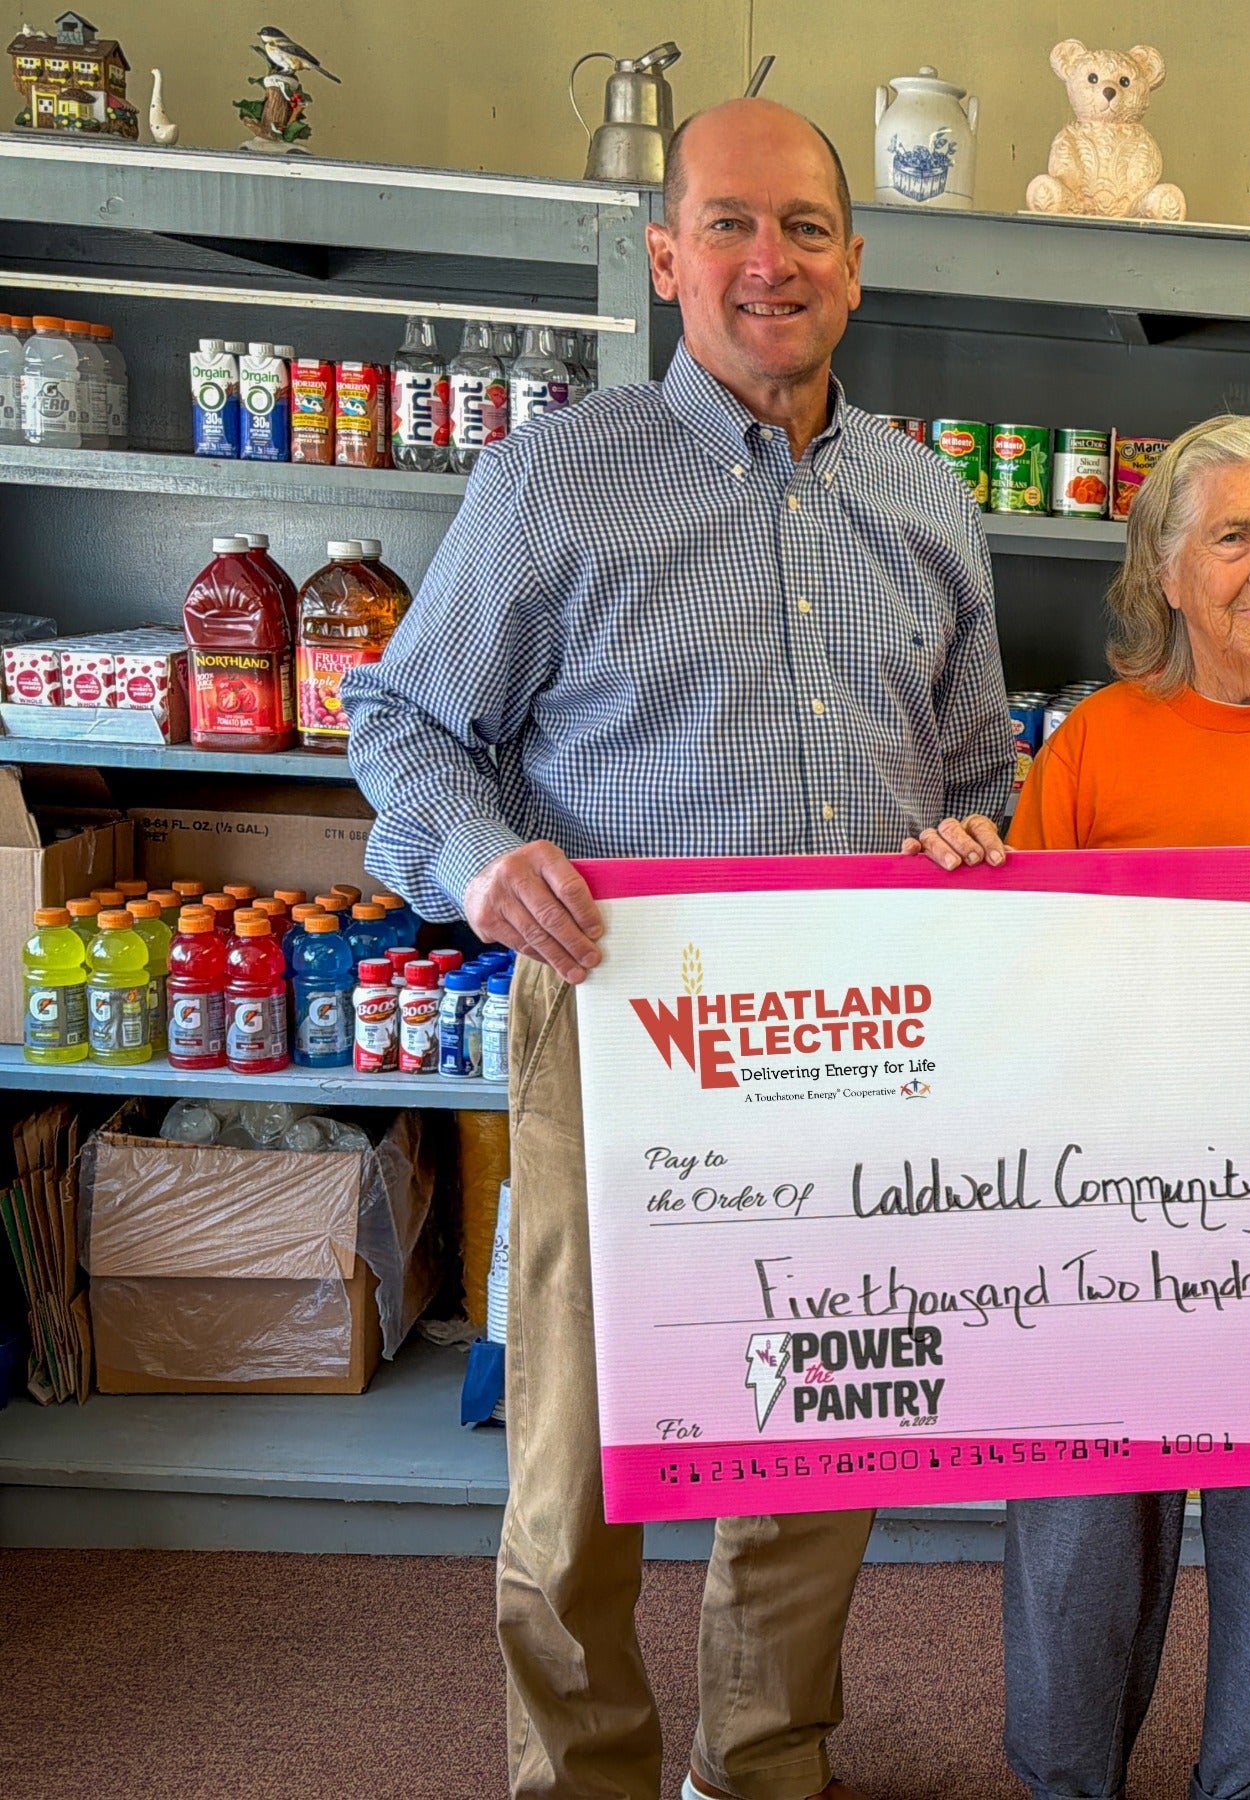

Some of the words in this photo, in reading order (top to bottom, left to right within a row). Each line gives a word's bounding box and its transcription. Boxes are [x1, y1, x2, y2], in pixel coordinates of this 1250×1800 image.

[192, 366, 231, 380] Orgain
[241, 369, 279, 384] Orgain
[292, 379, 328, 390] HORIZON
[336, 382, 370, 393] HORIZON
[37, 398, 70, 411] ERO
[406, 377, 432, 442] hint
[459, 381, 483, 445] hint
[523, 384, 548, 420] nt
[1133, 442, 1170, 453] Maru
[1080, 457, 1100, 467] Sliced
[195, 655, 269, 670] NORTHLAND
[315, 652, 352, 664] FRUIT
[171, 819, 190, 830] FL.
[192, 820, 212, 831] OZ.
[236, 823, 269, 837] GAL.)
[324, 828, 345, 839] CTN
[29, 991, 58, 1021] G
[90, 990, 111, 1021] G
[173, 999, 200, 1030] G
[309, 996, 338, 1027] G
[357, 997, 397, 1016] BOOS
[235, 1002, 263, 1034] G
[628, 984, 932, 1073] WHEATLAND
[698, 1018, 925, 1090] ELECTRIC
[741, 1065, 820, 1081] Delivering
[825, 1063, 878, 1078] Energy
[884, 1061, 904, 1074] for
[909, 1059, 936, 1073] Life
[744, 1093, 752, 1103] A
[754, 1091, 805, 1102] Touchstone
[842, 1087, 896, 1099] Cooperative
[644, 1146, 699, 1180] Pay
[704, 1149, 728, 1168] to
[647, 1188, 685, 1213] the
[692, 1185, 767, 1212] Order
[772, 1182, 815, 1216] Of
[1062, 1249, 1140, 1301] Two
[791, 1325, 943, 1373] POWER
[804, 1361, 835, 1385] the
[794, 1378, 946, 1423] PANTRY
[656, 1418, 703, 1440] For
